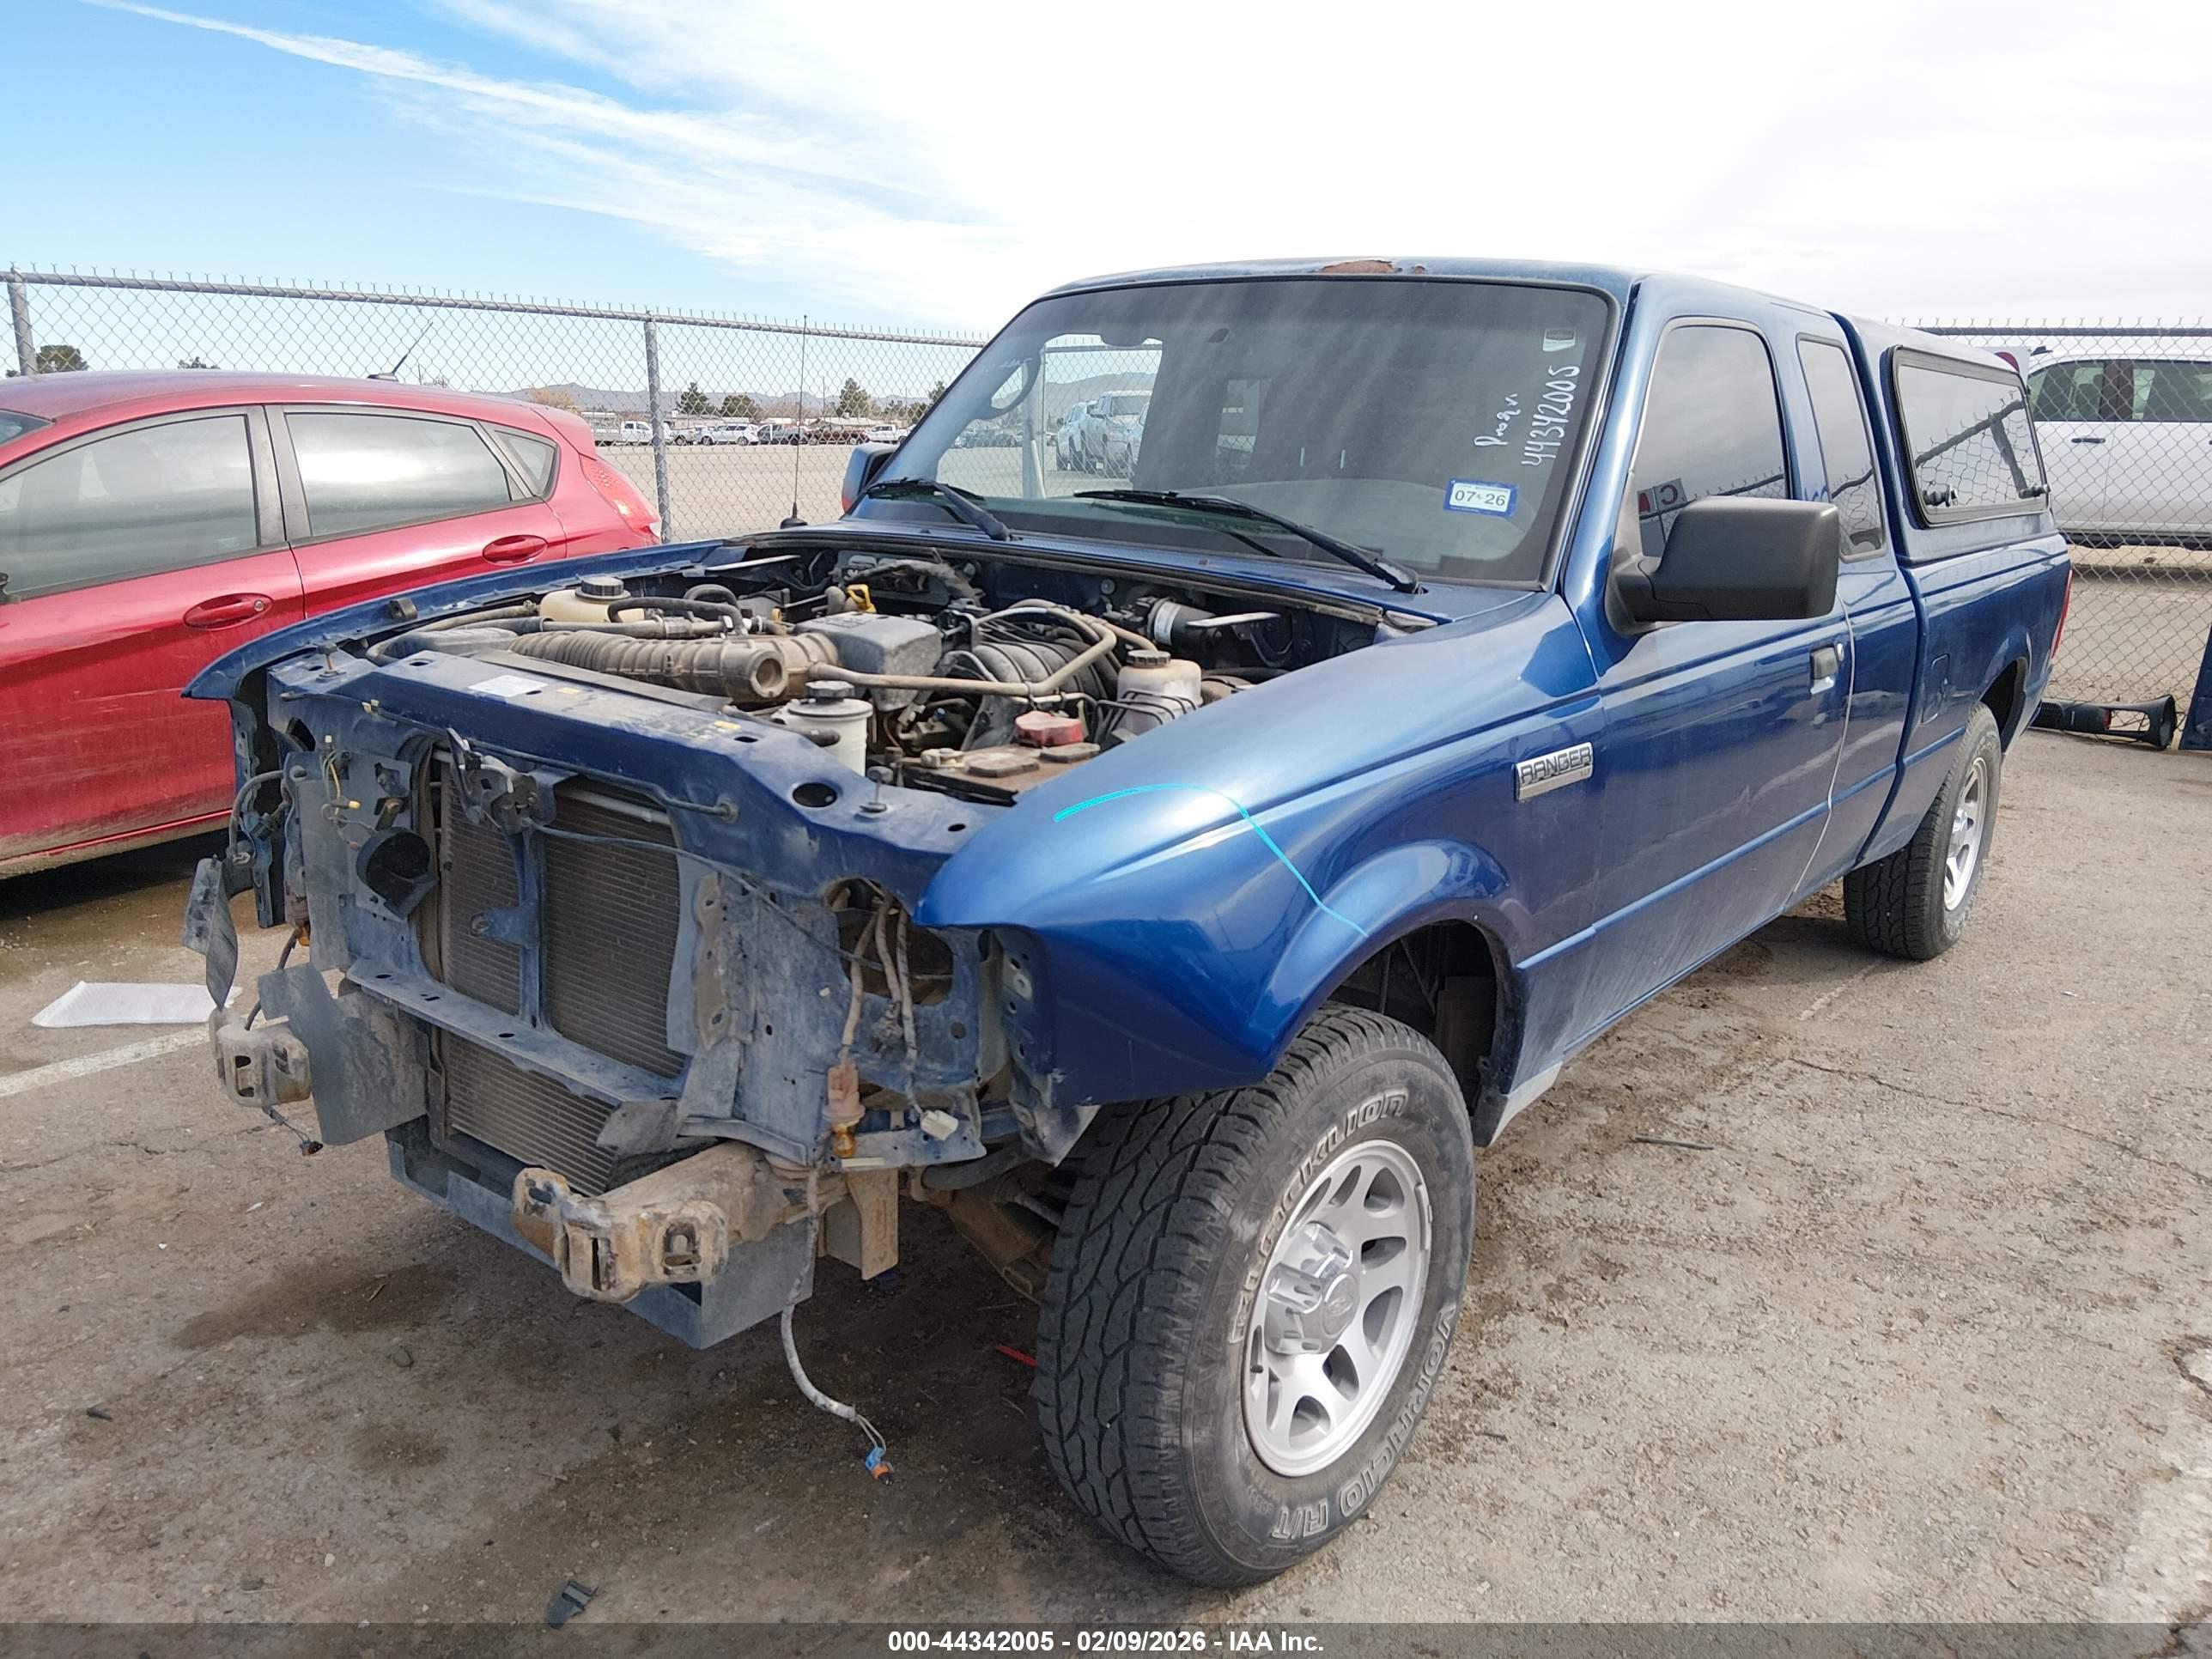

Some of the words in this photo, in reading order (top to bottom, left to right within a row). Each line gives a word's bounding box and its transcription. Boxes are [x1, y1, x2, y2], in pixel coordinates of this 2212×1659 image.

[1520, 363, 1581, 466] 44342005
[1455, 489, 1477, 502] 07
[1483, 493, 1506, 507] 26
[1520, 745, 1592, 784] RANGER
